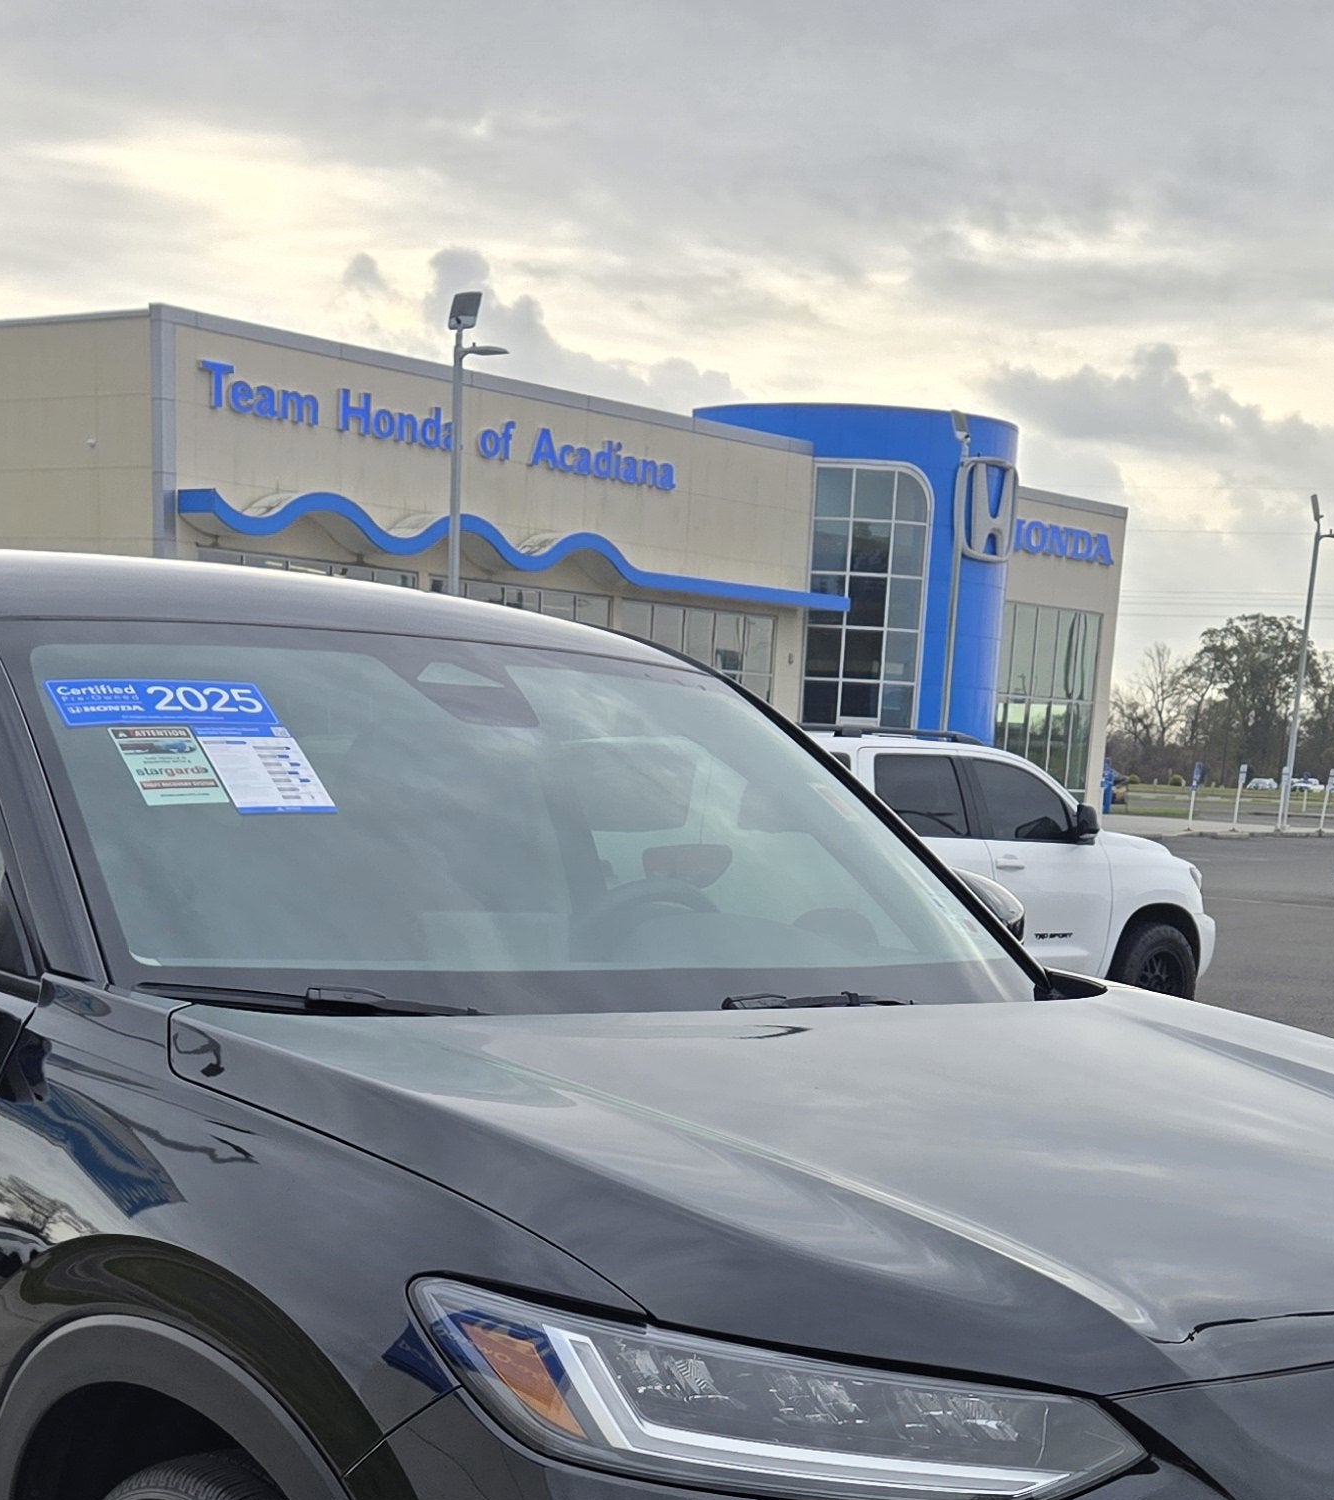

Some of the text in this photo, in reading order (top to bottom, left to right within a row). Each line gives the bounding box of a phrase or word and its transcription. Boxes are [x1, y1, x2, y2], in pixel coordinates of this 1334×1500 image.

[199, 359, 319, 427] Team
[478, 421, 517, 460] of
[529, 427, 677, 492] Acadiana
[56, 684, 137, 696] Certified
[146, 686, 264, 714] 2025
[83, 705, 146, 713] HONDA
[133, 728, 188, 737] ATTENTION
